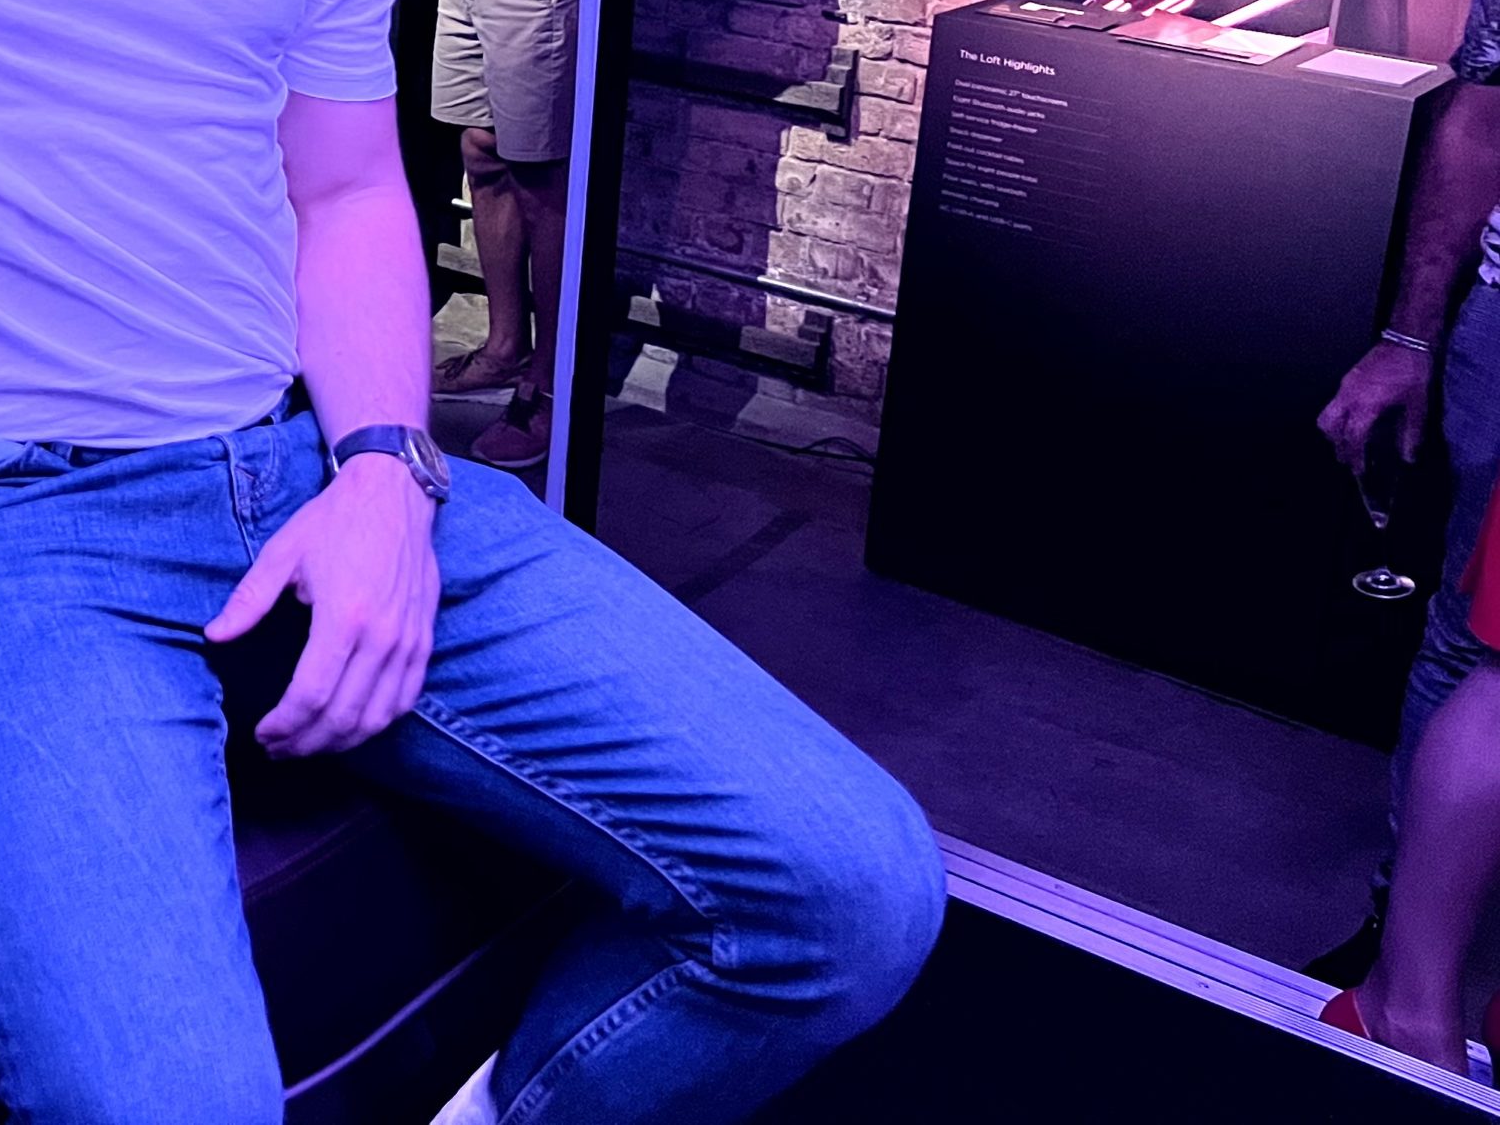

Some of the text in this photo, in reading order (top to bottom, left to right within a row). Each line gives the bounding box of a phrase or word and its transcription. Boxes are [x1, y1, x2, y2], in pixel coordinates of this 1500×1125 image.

[960, 49, 1056, 76] The Loft Highlights
